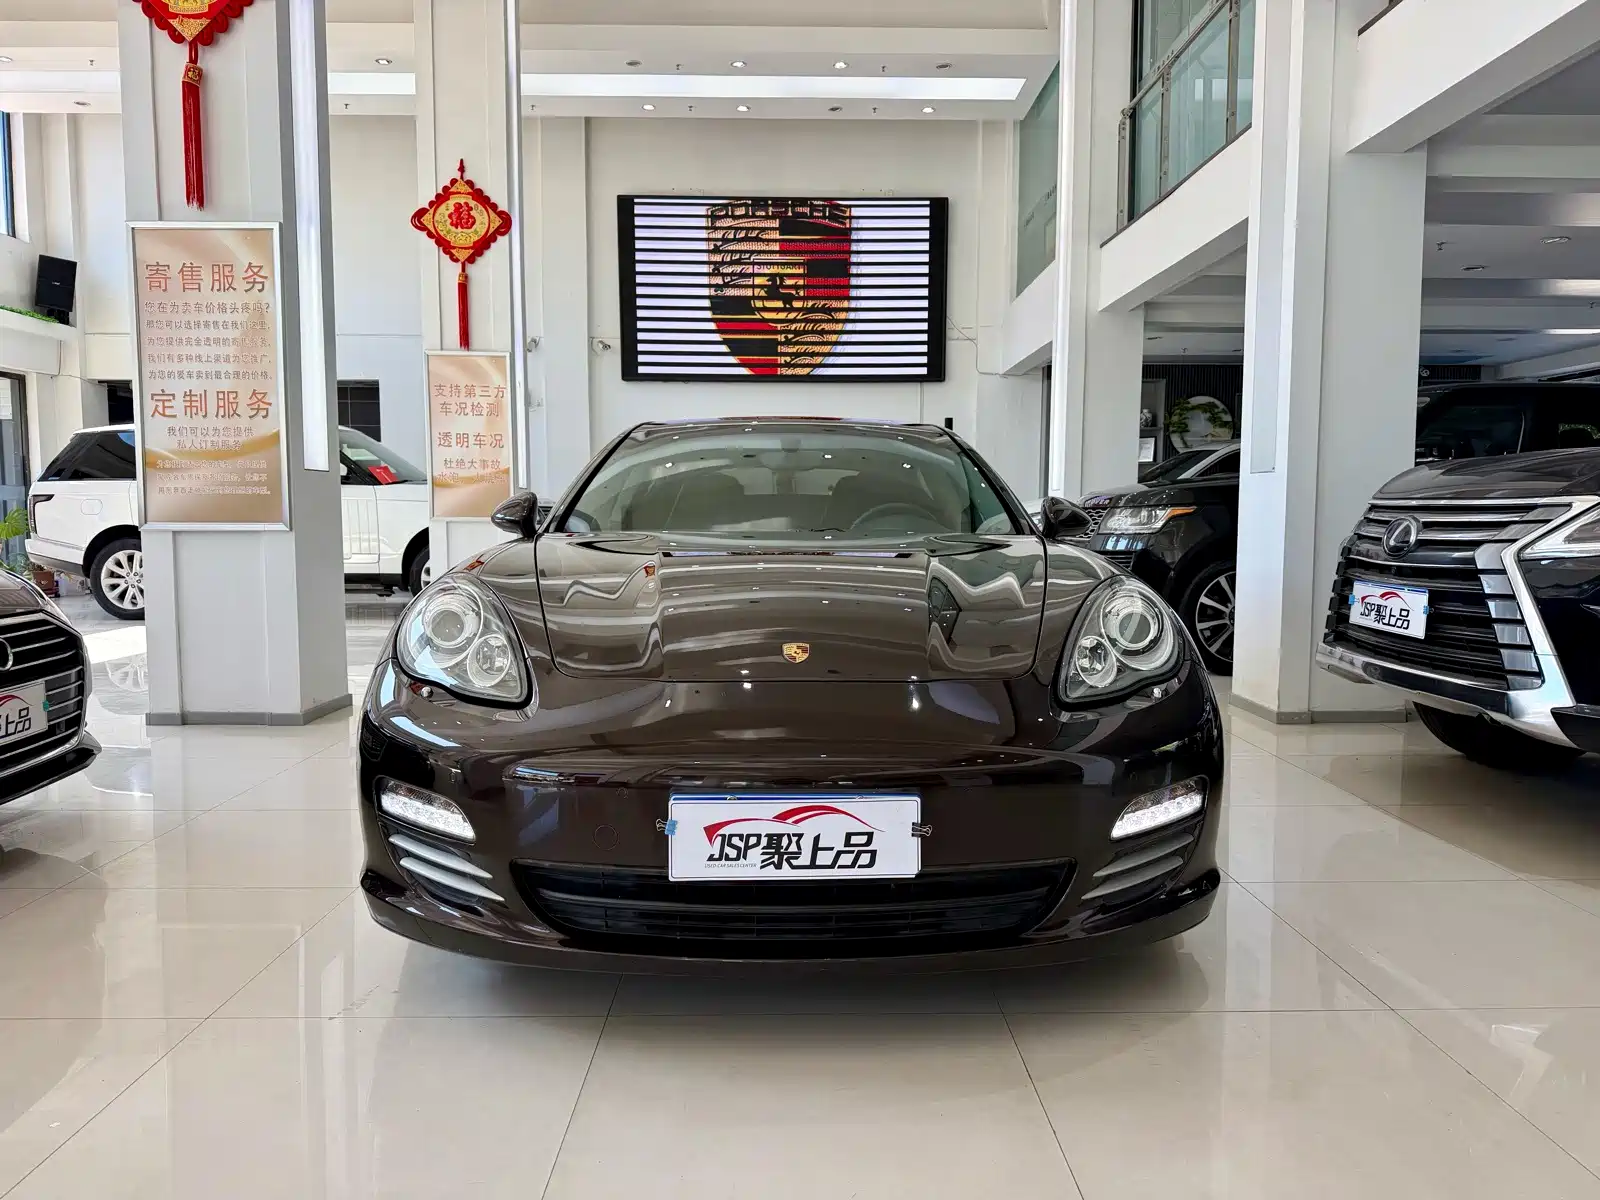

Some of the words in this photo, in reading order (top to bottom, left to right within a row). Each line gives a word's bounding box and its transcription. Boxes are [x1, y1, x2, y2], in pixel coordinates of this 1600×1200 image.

[448, 202, 476, 230] 福
[145, 261, 269, 293] 寄售服务
[434, 384, 506, 399] 支持第三方
[150, 388, 273, 419] 定制服务
[440, 401, 500, 417] 车况检测
[437, 431, 505, 449] 透明车况
[443, 457, 501, 470] 杜绝大事故
